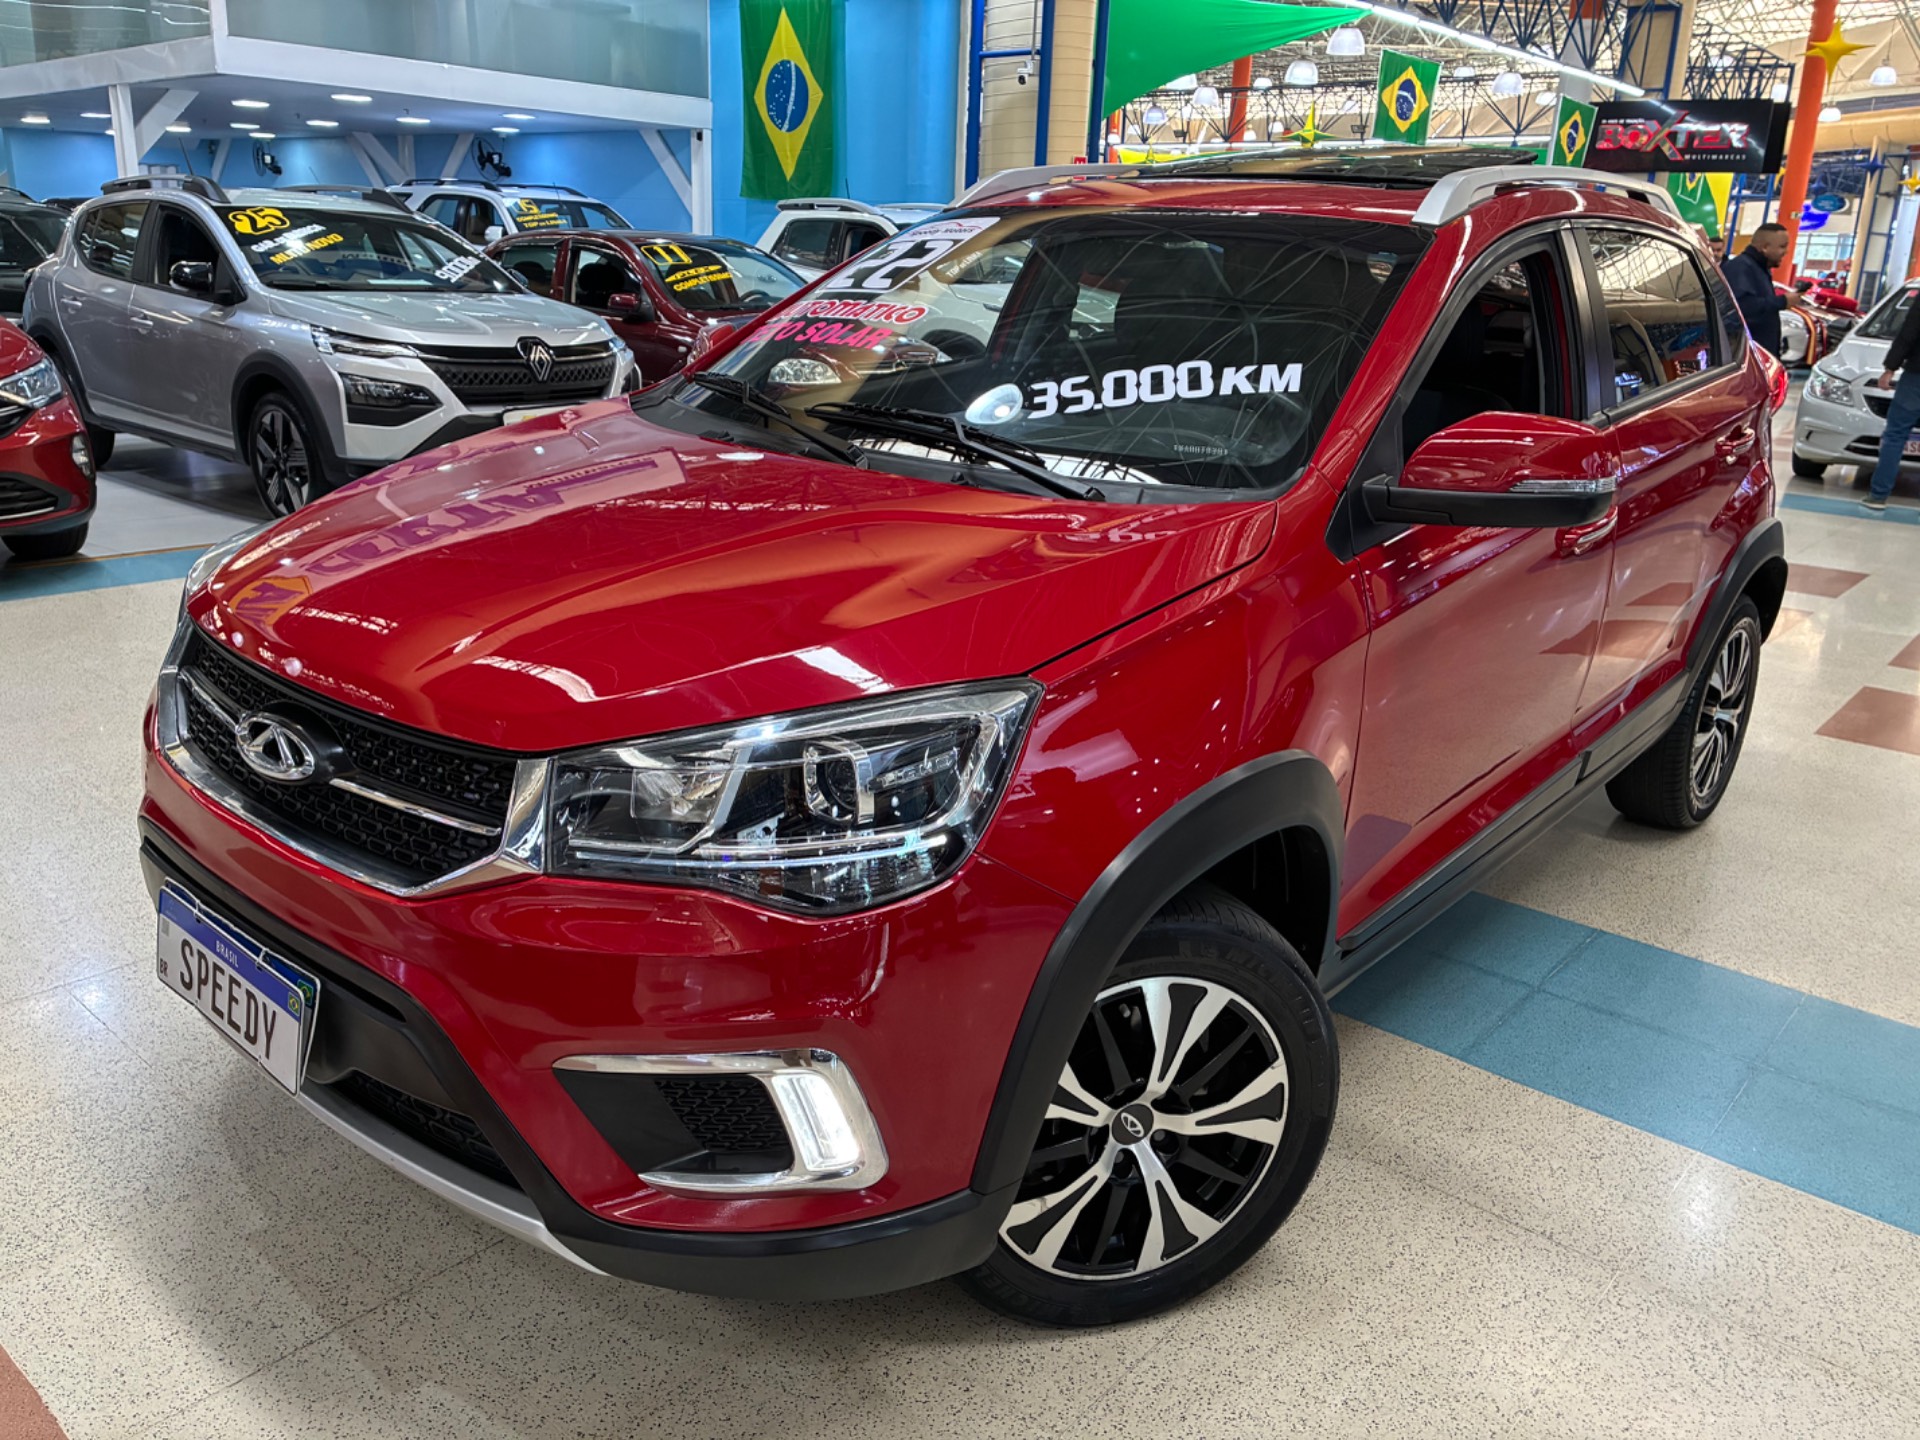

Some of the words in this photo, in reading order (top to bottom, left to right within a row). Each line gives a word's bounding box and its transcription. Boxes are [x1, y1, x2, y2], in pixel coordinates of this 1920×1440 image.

[1596, 110, 1750, 160] BOXTER
[228, 206, 290, 235] 25
[305, 233, 344, 250] NOVO
[824, 239, 954, 289] 22
[766, 299, 930, 324] UTOMATICO
[741, 321, 806, 344] ETO
[794, 321, 894, 349] SOLAR
[1027, 360, 1214, 419] 35.000
[1219, 362, 1303, 396] KM
[159, 958, 169, 977] BR
[215, 939, 239, 968] BRASIL
[179, 938, 277, 1060] SPEEDY
